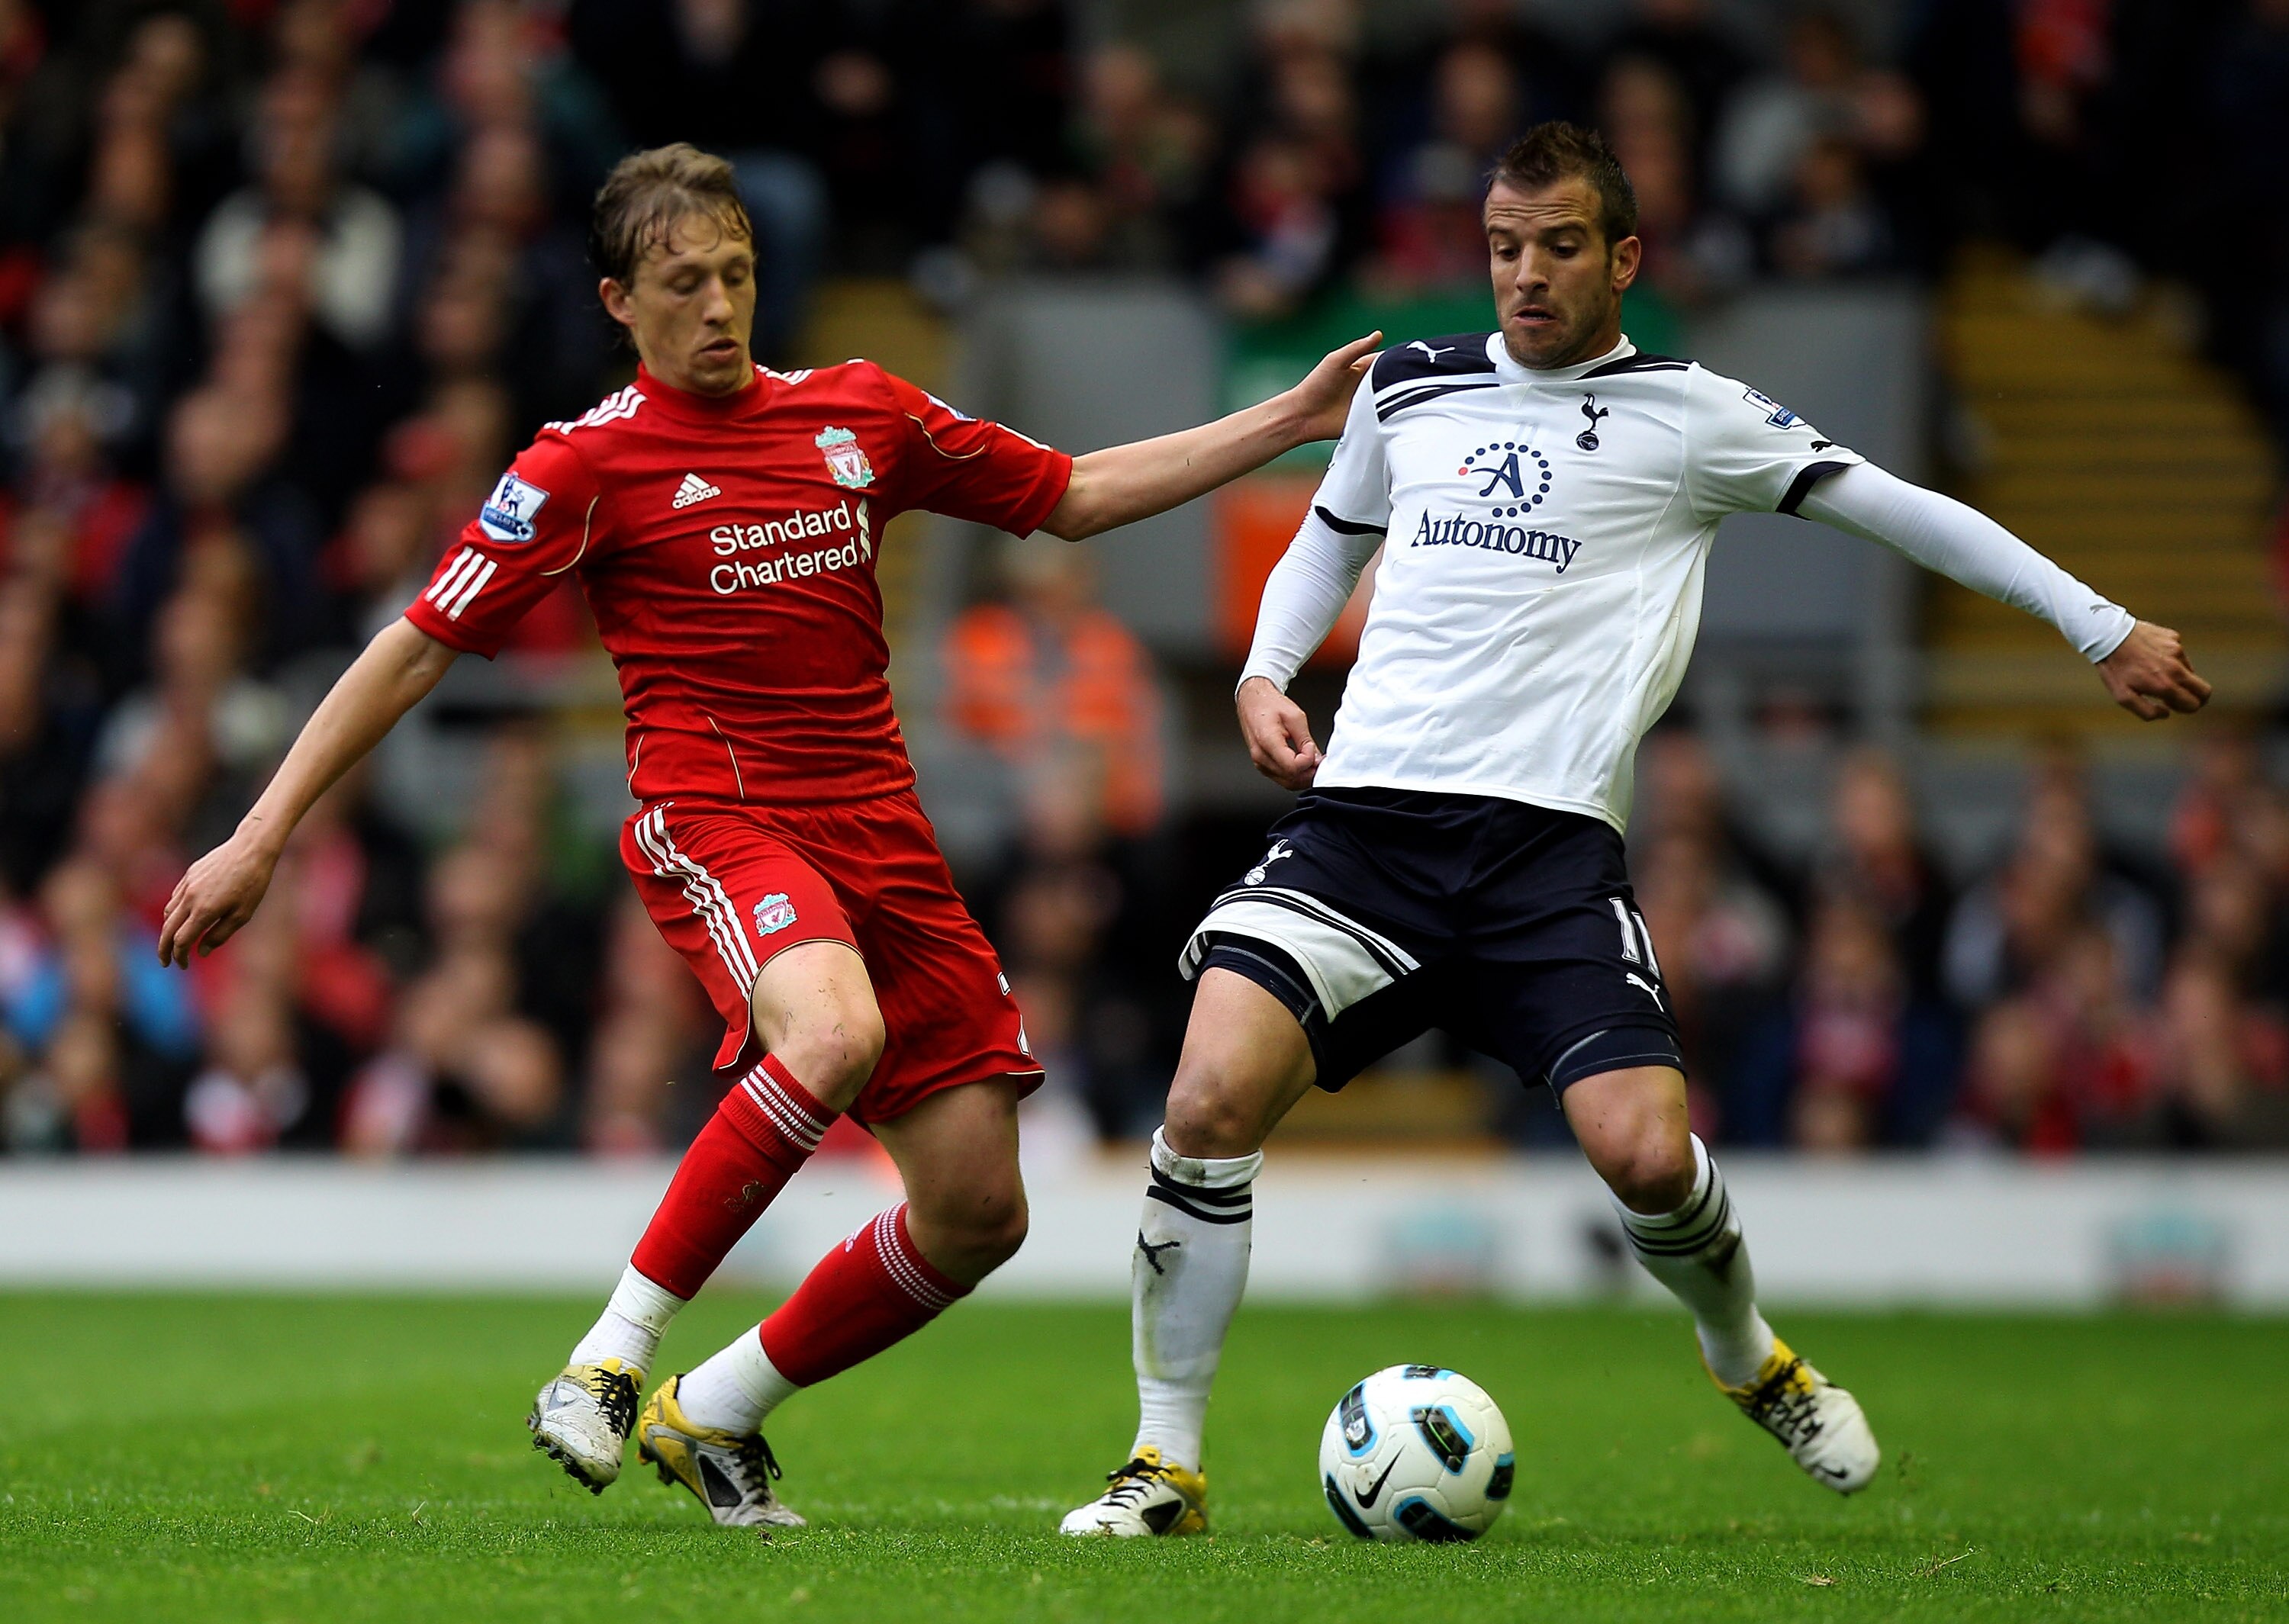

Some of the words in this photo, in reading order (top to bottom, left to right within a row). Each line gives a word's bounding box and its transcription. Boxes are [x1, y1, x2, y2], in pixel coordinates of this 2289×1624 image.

[672, 486, 721, 509] adidas
[710, 500, 852, 556] Standard
[1411, 507, 1582, 574] Autonomy
[710, 536, 858, 595] Chartered
[1608, 897, 1661, 981] 11
